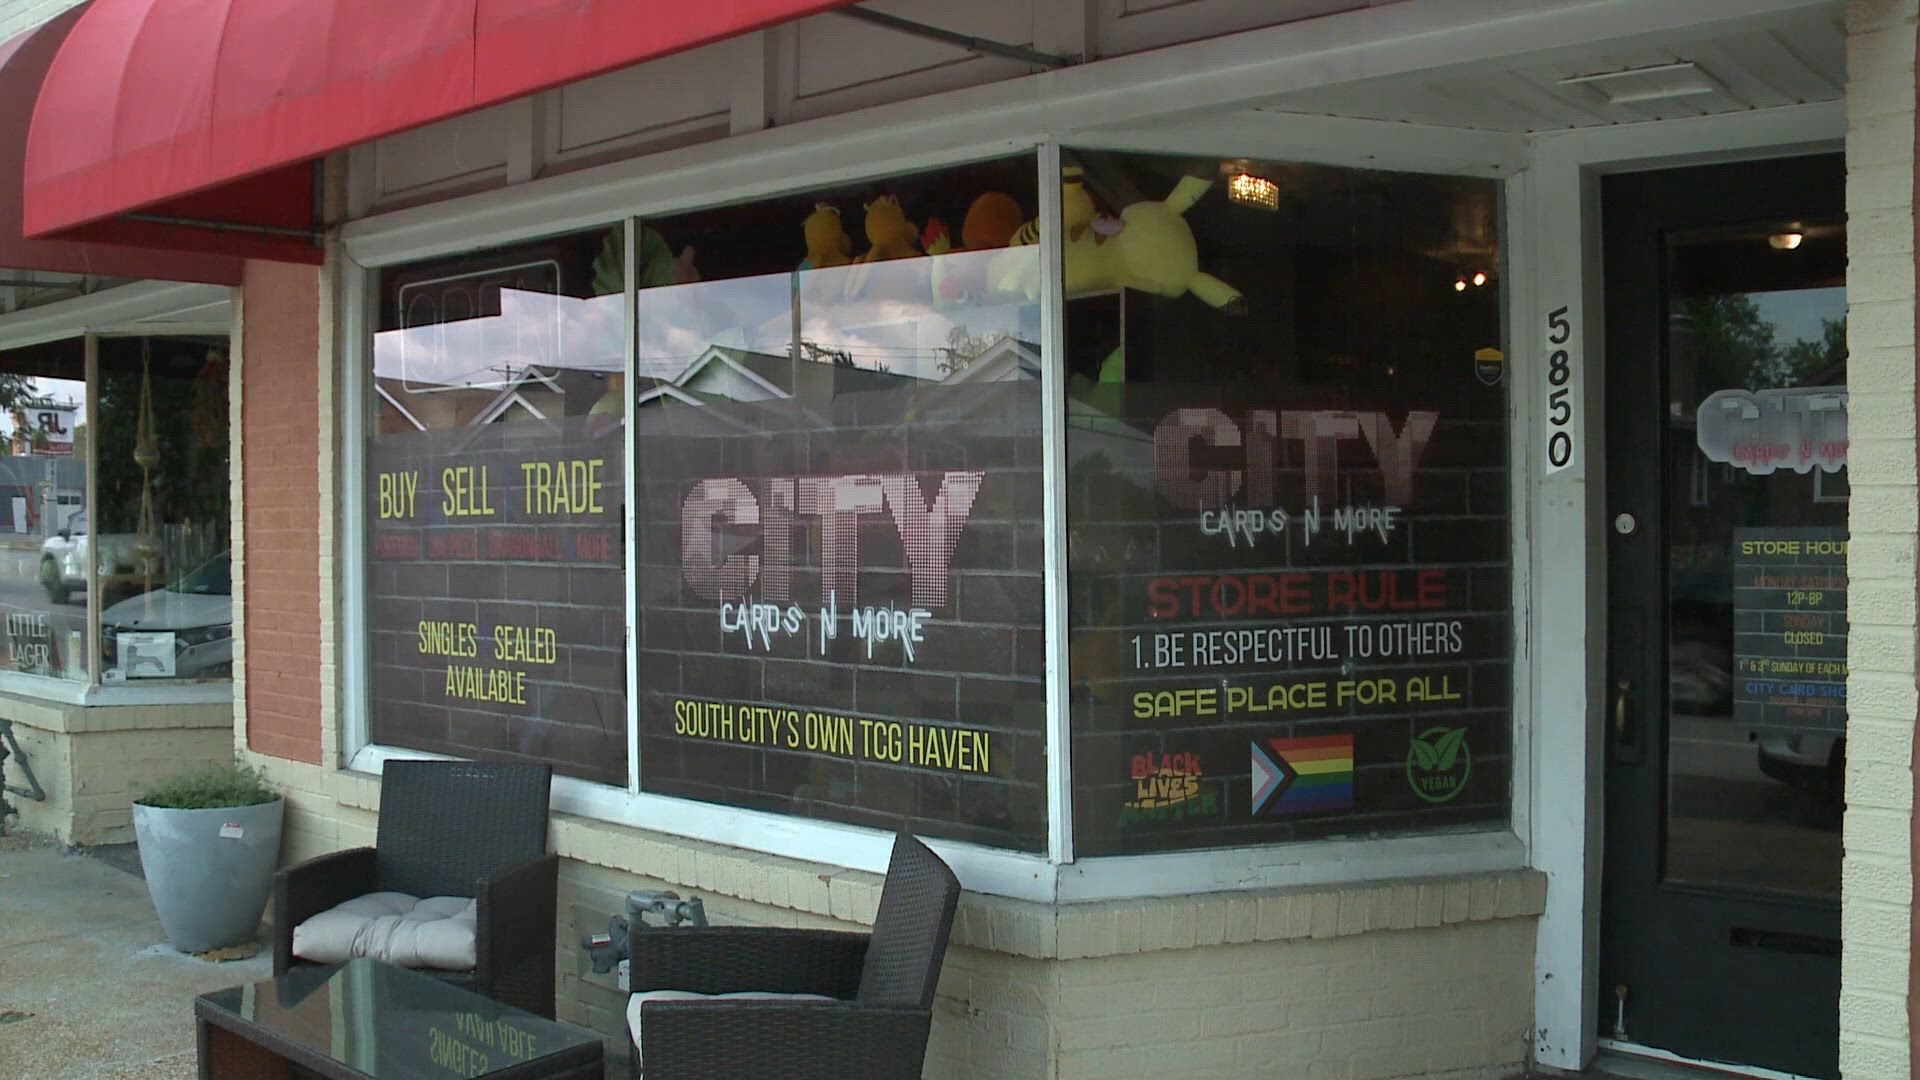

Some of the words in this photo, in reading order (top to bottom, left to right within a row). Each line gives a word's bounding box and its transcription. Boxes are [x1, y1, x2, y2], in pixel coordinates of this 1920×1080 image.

[1549, 306, 1571, 467] 5850
[1703, 393, 1848, 448] CIT
[1154, 408, 1440, 508] CITY
[380, 471, 418, 519] BUY
[442, 465, 495, 516] SELL
[521, 459, 604, 514] TRADE
[681, 471, 985, 607] CITY
[1201, 504, 1288, 548] CARDS
[1304, 495, 1320, 547] N
[1334, 506, 1402, 546] MORE
[1742, 541, 1800, 555] STORE
[1148, 573, 1311, 619] STORE
[1328, 570, 1448, 611] RULE
[1787, 592, 1822, 606] 12P-8P
[6, 613, 46, 638] LITTLE
[418, 620, 477, 658] SINGLES
[494, 624, 557, 664] SEALED
[720, 596, 806, 651] CARDS
[820, 590, 837, 656] N
[853, 603, 932, 662] MORE
[1131, 636, 1149, 669] 1.
[1155, 633, 1185, 668] BE
[1193, 626, 1338, 665] RESPECTFUL
[1344, 625, 1373, 658] TO
[1379, 622, 1463, 655] OTHERS
[1784, 631, 1824, 645] CLOSED
[9, 641, 50, 668] LAGER
[1771, 660, 1805, 673] SUNDAY
[1806, 662, 1816, 674] OF
[1818, 663, 1842, 675] EACH
[446, 665, 526, 704] AVAILABLE
[1133, 688, 1217, 719] SAFE
[1227, 682, 1326, 712] PLACE
[1337, 678, 1397, 708] FOR
[1406, 674, 1461, 701] ALL
[1745, 682, 1775, 695] CITY
[1780, 683, 1815, 697] CARD
[675, 700, 734, 740] SOUTH
[739, 706, 800, 748] CITY'S
[805, 712, 854, 756] OWN
[860, 719, 901, 762] TCG
[909, 725, 989, 772] HAVEN
[1132, 751, 1202, 780] BLACK
[1137, 775, 1199, 800] LIVES
[1422, 775, 1457, 791] VEGAN
